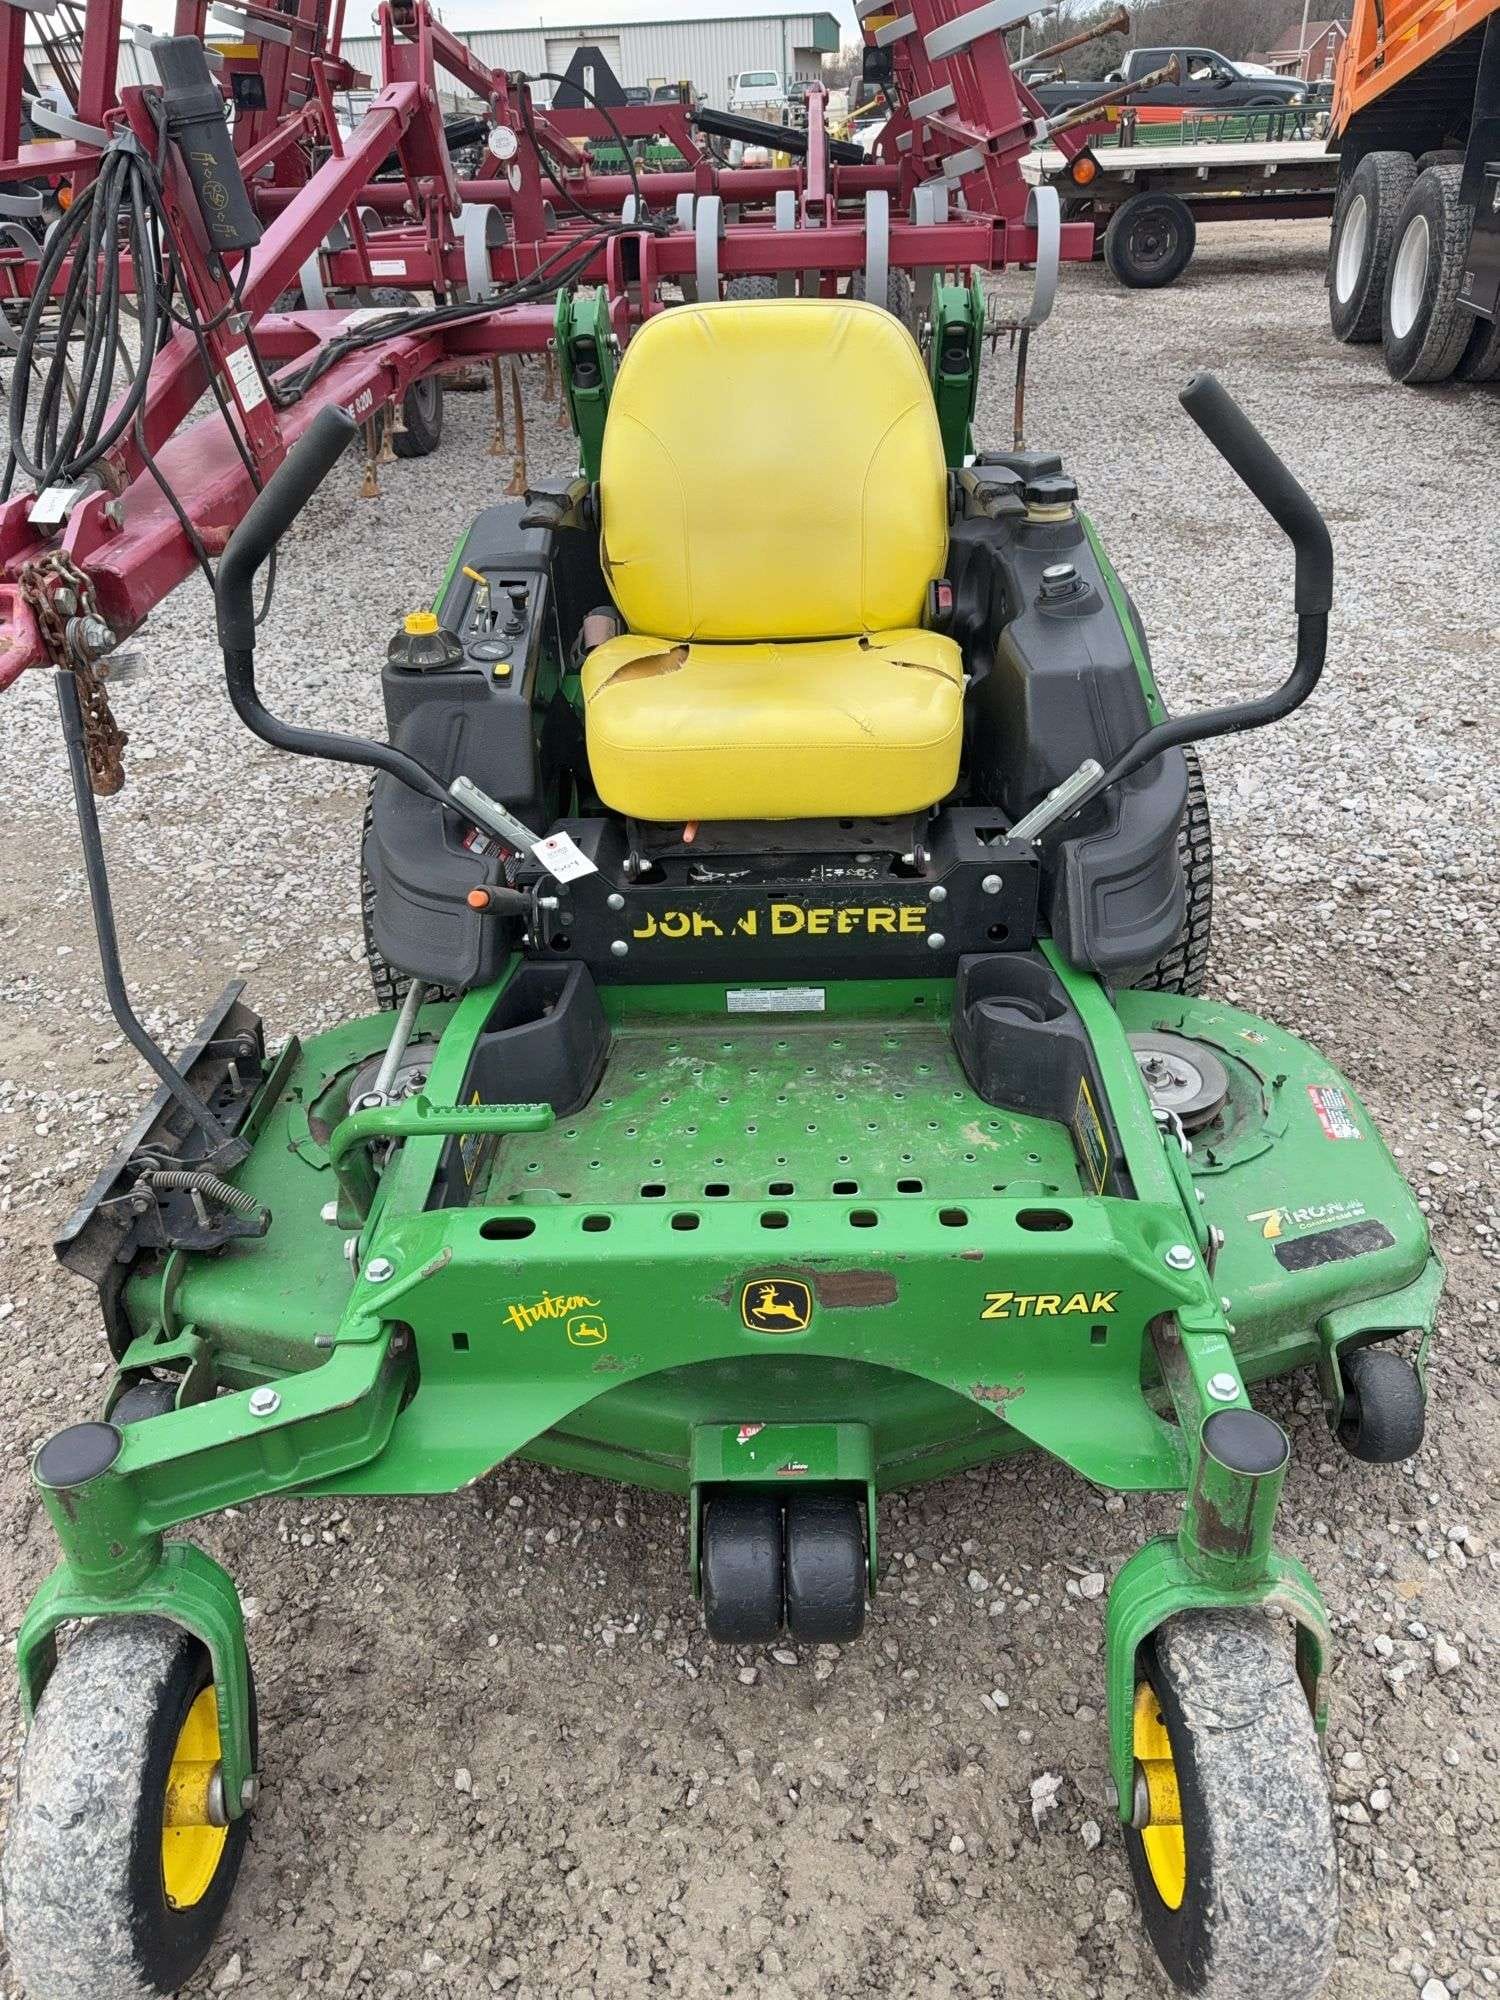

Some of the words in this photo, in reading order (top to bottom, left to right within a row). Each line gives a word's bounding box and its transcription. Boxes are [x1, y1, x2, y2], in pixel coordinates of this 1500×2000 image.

[771, 903, 928, 935] DEERE
[502, 1291, 600, 1332] Hutson
[981, 1291, 1120, 1319] ZTRAK
